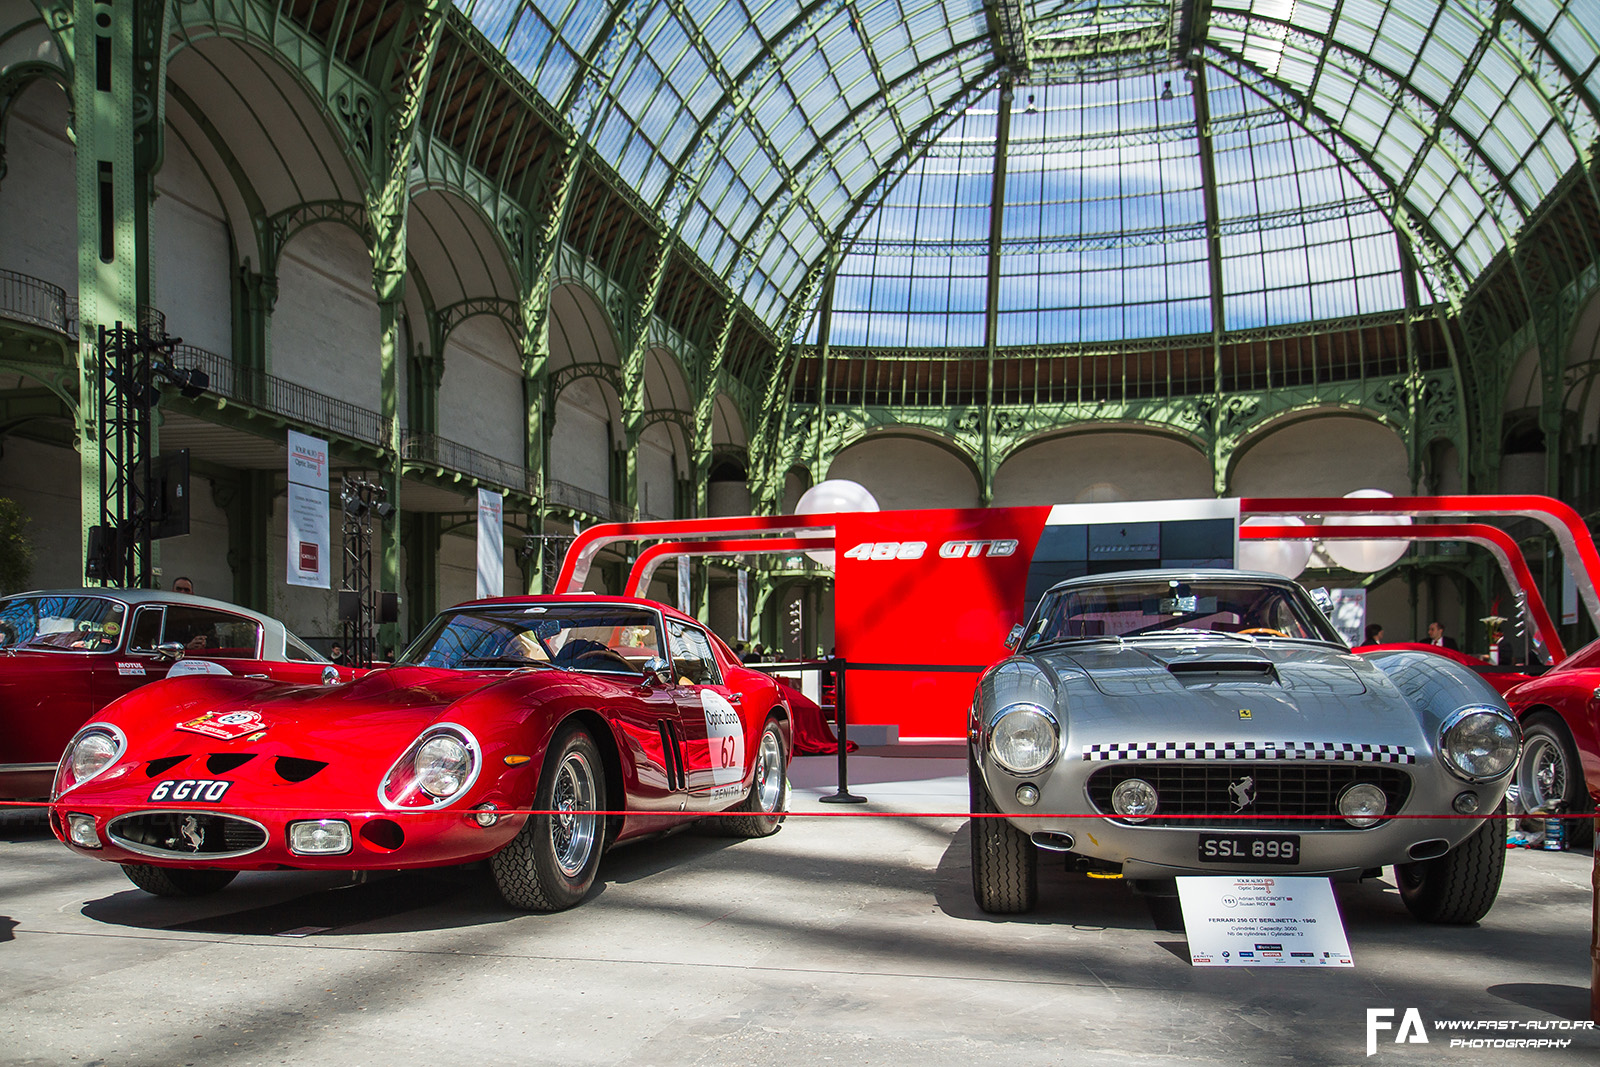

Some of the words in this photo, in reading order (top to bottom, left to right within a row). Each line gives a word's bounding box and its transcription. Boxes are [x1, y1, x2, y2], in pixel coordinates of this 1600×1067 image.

[844, 541, 928, 561] 488
[938, 539, 1020, 559] GTB
[705, 709, 725, 731] Optic
[722, 709, 739, 725] 2000
[721, 735, 736, 769] 62
[151, 780, 175, 801] 6
[172, 780, 229, 801] GTO
[713, 787, 739, 801] ZENITH
[1204, 840, 1246, 857] SSL
[1252, 840, 1294, 859] 899
